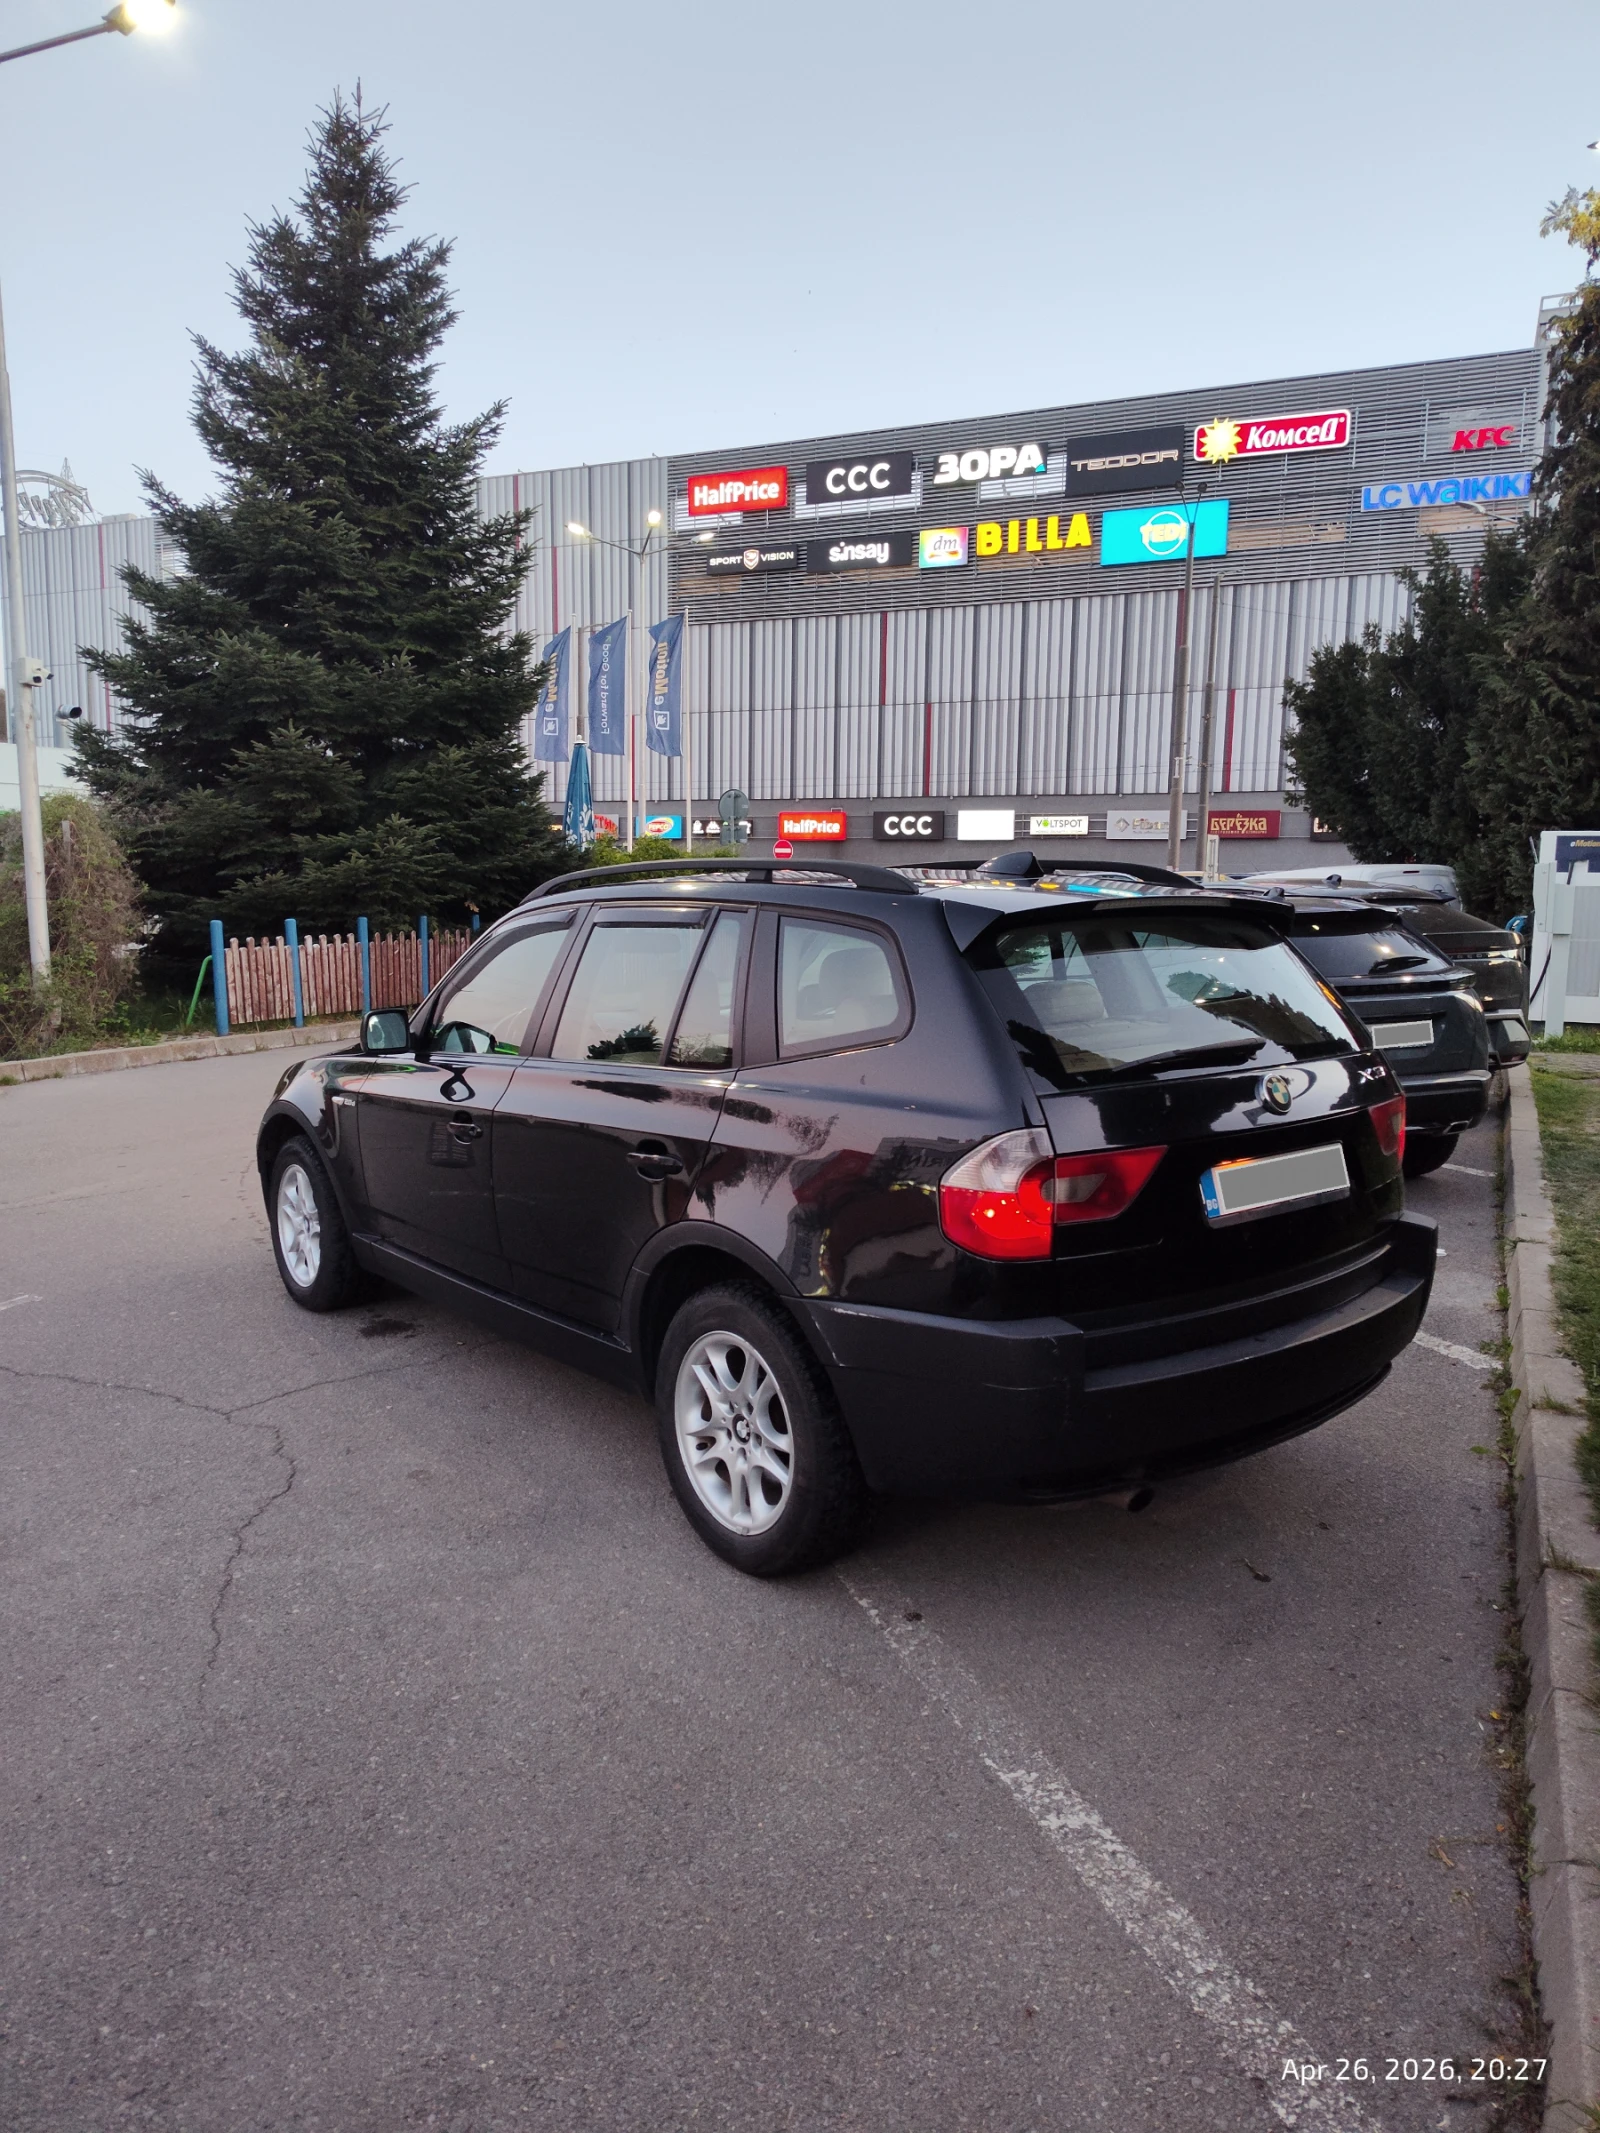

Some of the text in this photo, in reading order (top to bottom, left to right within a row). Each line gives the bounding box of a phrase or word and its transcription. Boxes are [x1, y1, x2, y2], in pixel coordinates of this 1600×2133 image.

[1452, 425, 1515, 451] KFC
[1070, 449, 1179, 472] TEODOR
[826, 463, 891, 494] CCC
[694, 481, 780, 507] HalfPrice
[1363, 484, 1403, 510] LC
[933, 534, 958, 551] dm
[975, 513, 1093, 556] BILLA
[709, 551, 794, 567] SPORT VISION
[829, 541, 890, 564] sinsay
[783, 819, 841, 833] HalfPrice
[884, 816, 933, 836] CCC
[1207, 1198, 1219, 1210] BG
